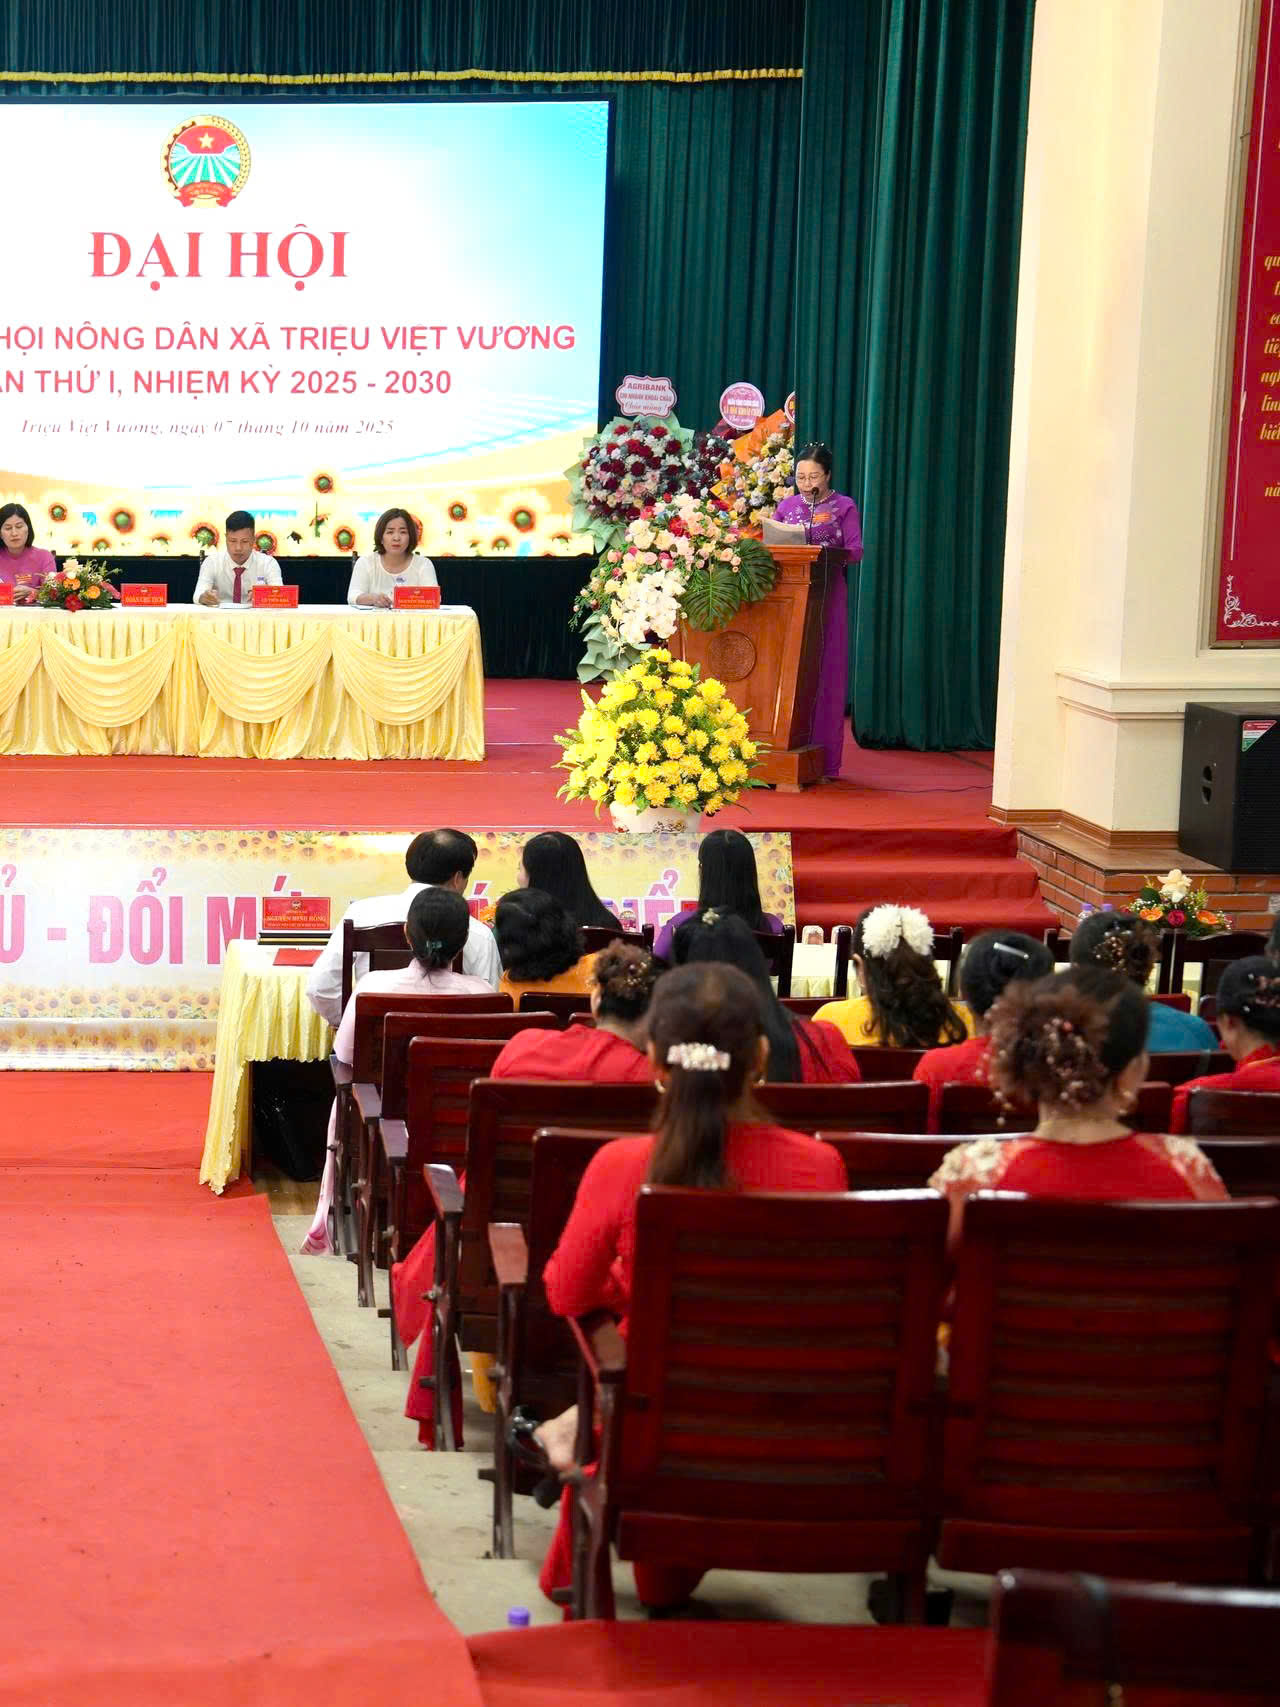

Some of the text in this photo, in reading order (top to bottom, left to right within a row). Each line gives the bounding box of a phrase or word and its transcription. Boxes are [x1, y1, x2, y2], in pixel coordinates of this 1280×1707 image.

[88, 232, 204, 291] ĐẠI
[55, 321, 145, 350] NÔNG
[154, 321, 219, 350] DÂN
[229, 321, 270, 350] XÃ
[280, 325, 370, 356] TRIỆU
[381, 325, 447, 356] VIỆT
[457, 325, 575, 350] VƯƠNG
[34, 364, 102, 394] THỨ
[290, 370, 357, 394] 2025
[384, 370, 452, 394] 2030
[627, 383, 667, 391] AGRIBANK
[292, 420, 310, 433] 10
[356, 420, 395, 434] 2025
[86, 866, 183, 965] ĐỔI
